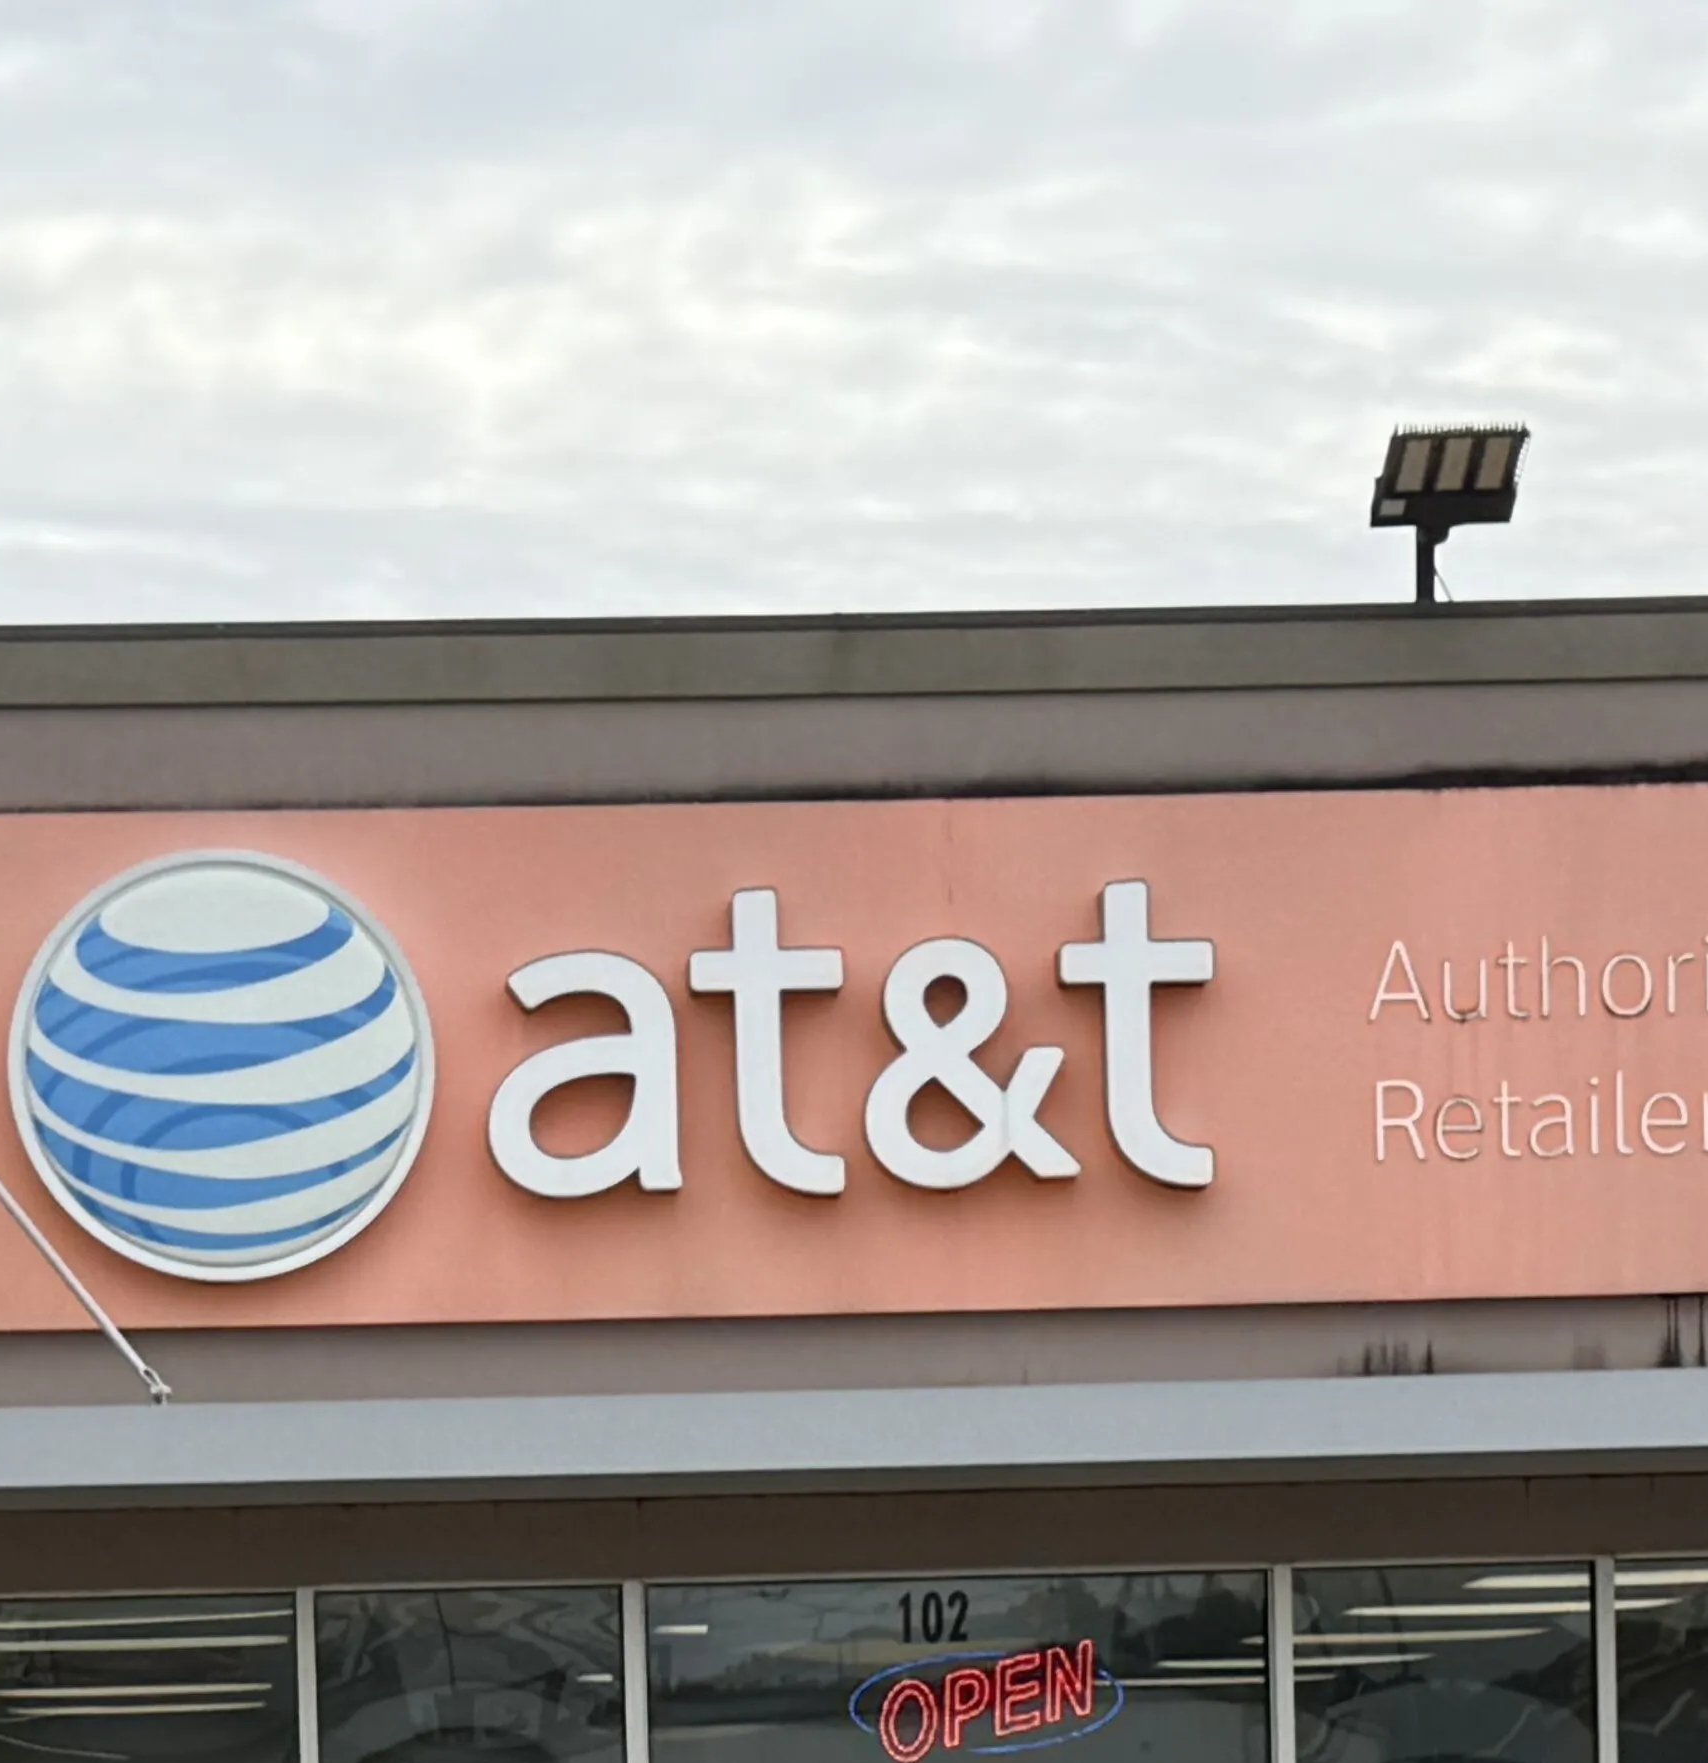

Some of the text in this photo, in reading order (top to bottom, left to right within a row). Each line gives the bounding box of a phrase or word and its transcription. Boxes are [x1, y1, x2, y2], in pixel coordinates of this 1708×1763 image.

[489, 879, 1215, 1198] at&t
[897, 1590, 969, 1644] 102
[880, 1639, 1094, 1763] OPEN
